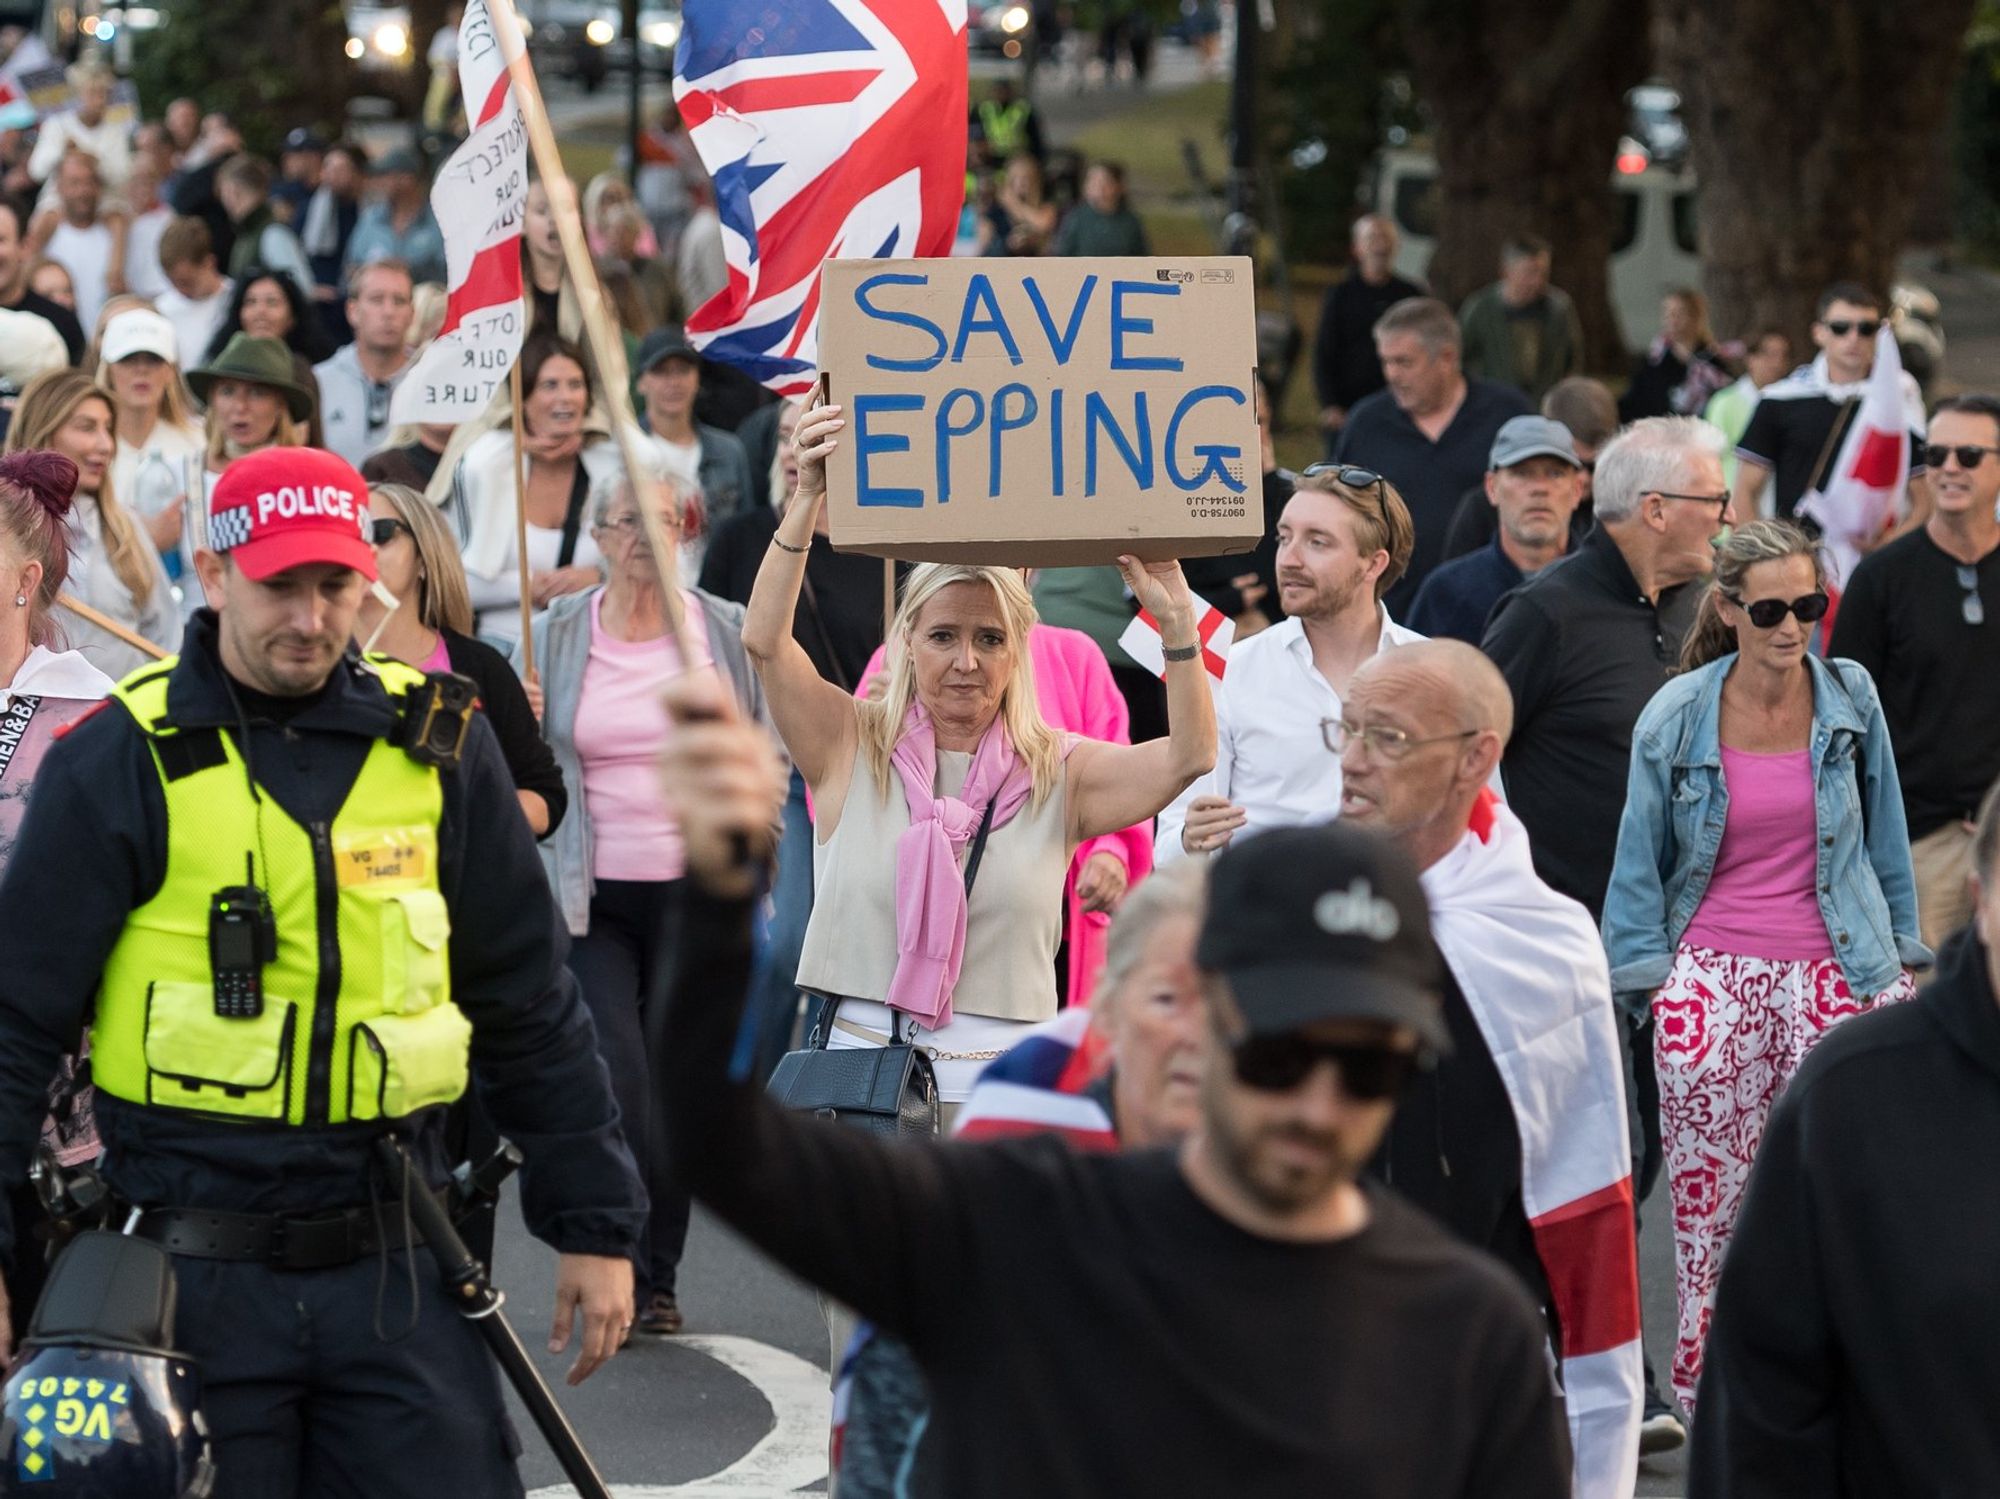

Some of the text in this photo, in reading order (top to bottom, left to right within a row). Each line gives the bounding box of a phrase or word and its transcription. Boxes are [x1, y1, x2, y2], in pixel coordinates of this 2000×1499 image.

[464, 0, 496, 61] TECT
[854, 273, 1184, 372] SAVE
[854, 383, 1248, 508] EPPING
[257, 486, 354, 525] POLICE
[20, 1376, 127, 1405] 74405
[55, 1398, 111, 1440] VG
